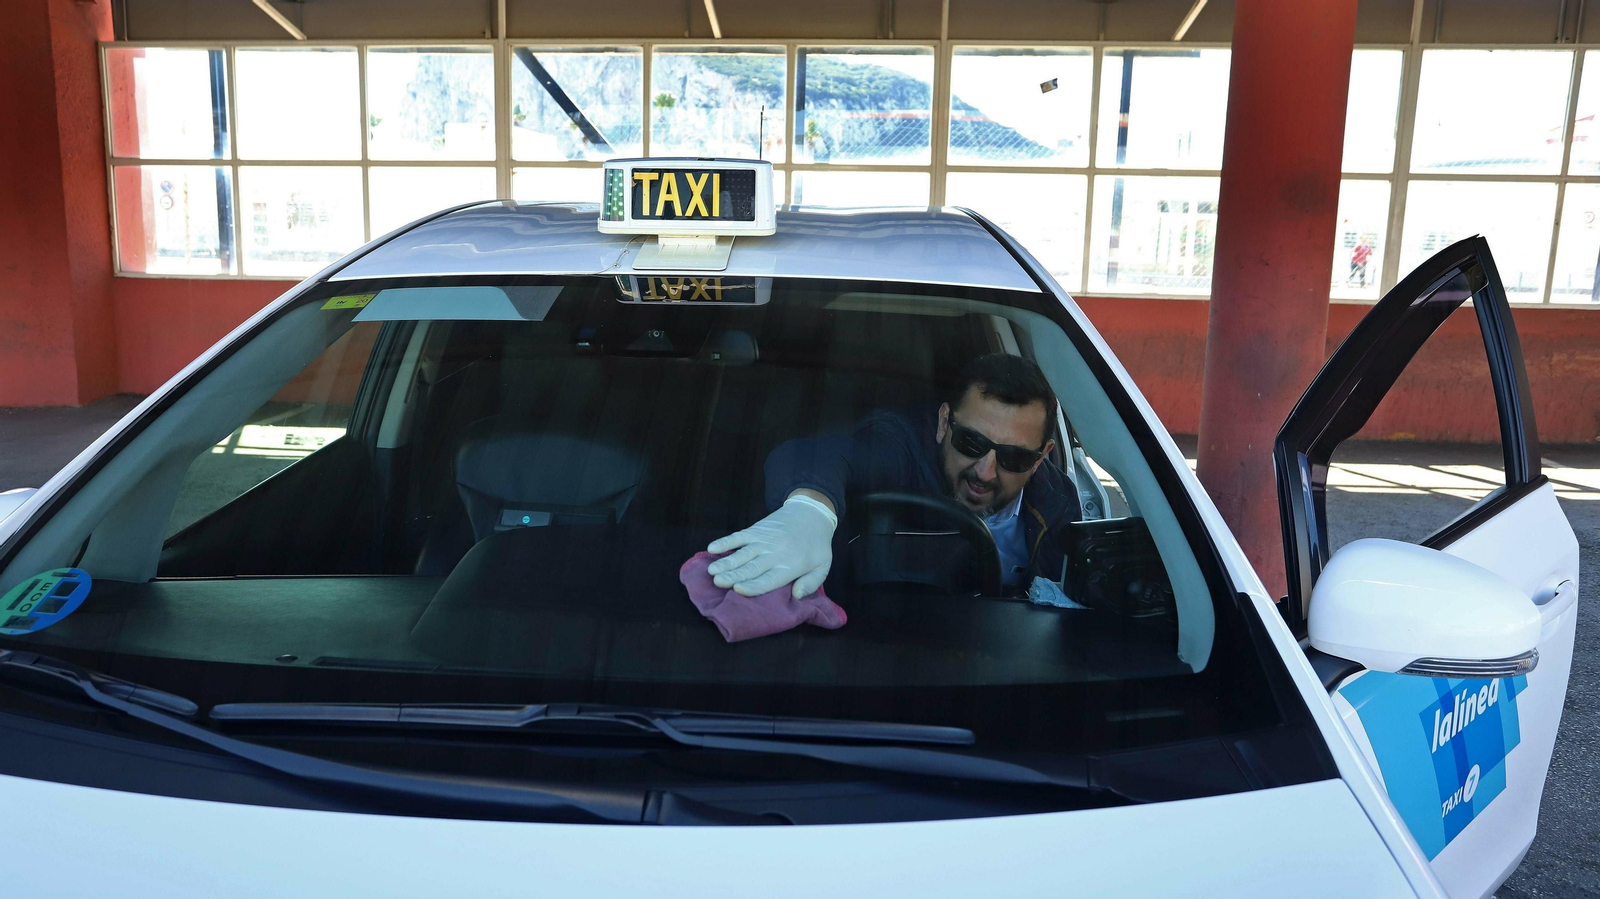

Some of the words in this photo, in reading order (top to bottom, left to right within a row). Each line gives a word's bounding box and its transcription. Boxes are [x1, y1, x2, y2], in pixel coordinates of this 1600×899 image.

[633, 172, 720, 217] TAXI
[19, 582, 53, 613] ECO
[1431, 677, 1500, 754] lalínea
[1442, 786, 1463, 818] TAXI
